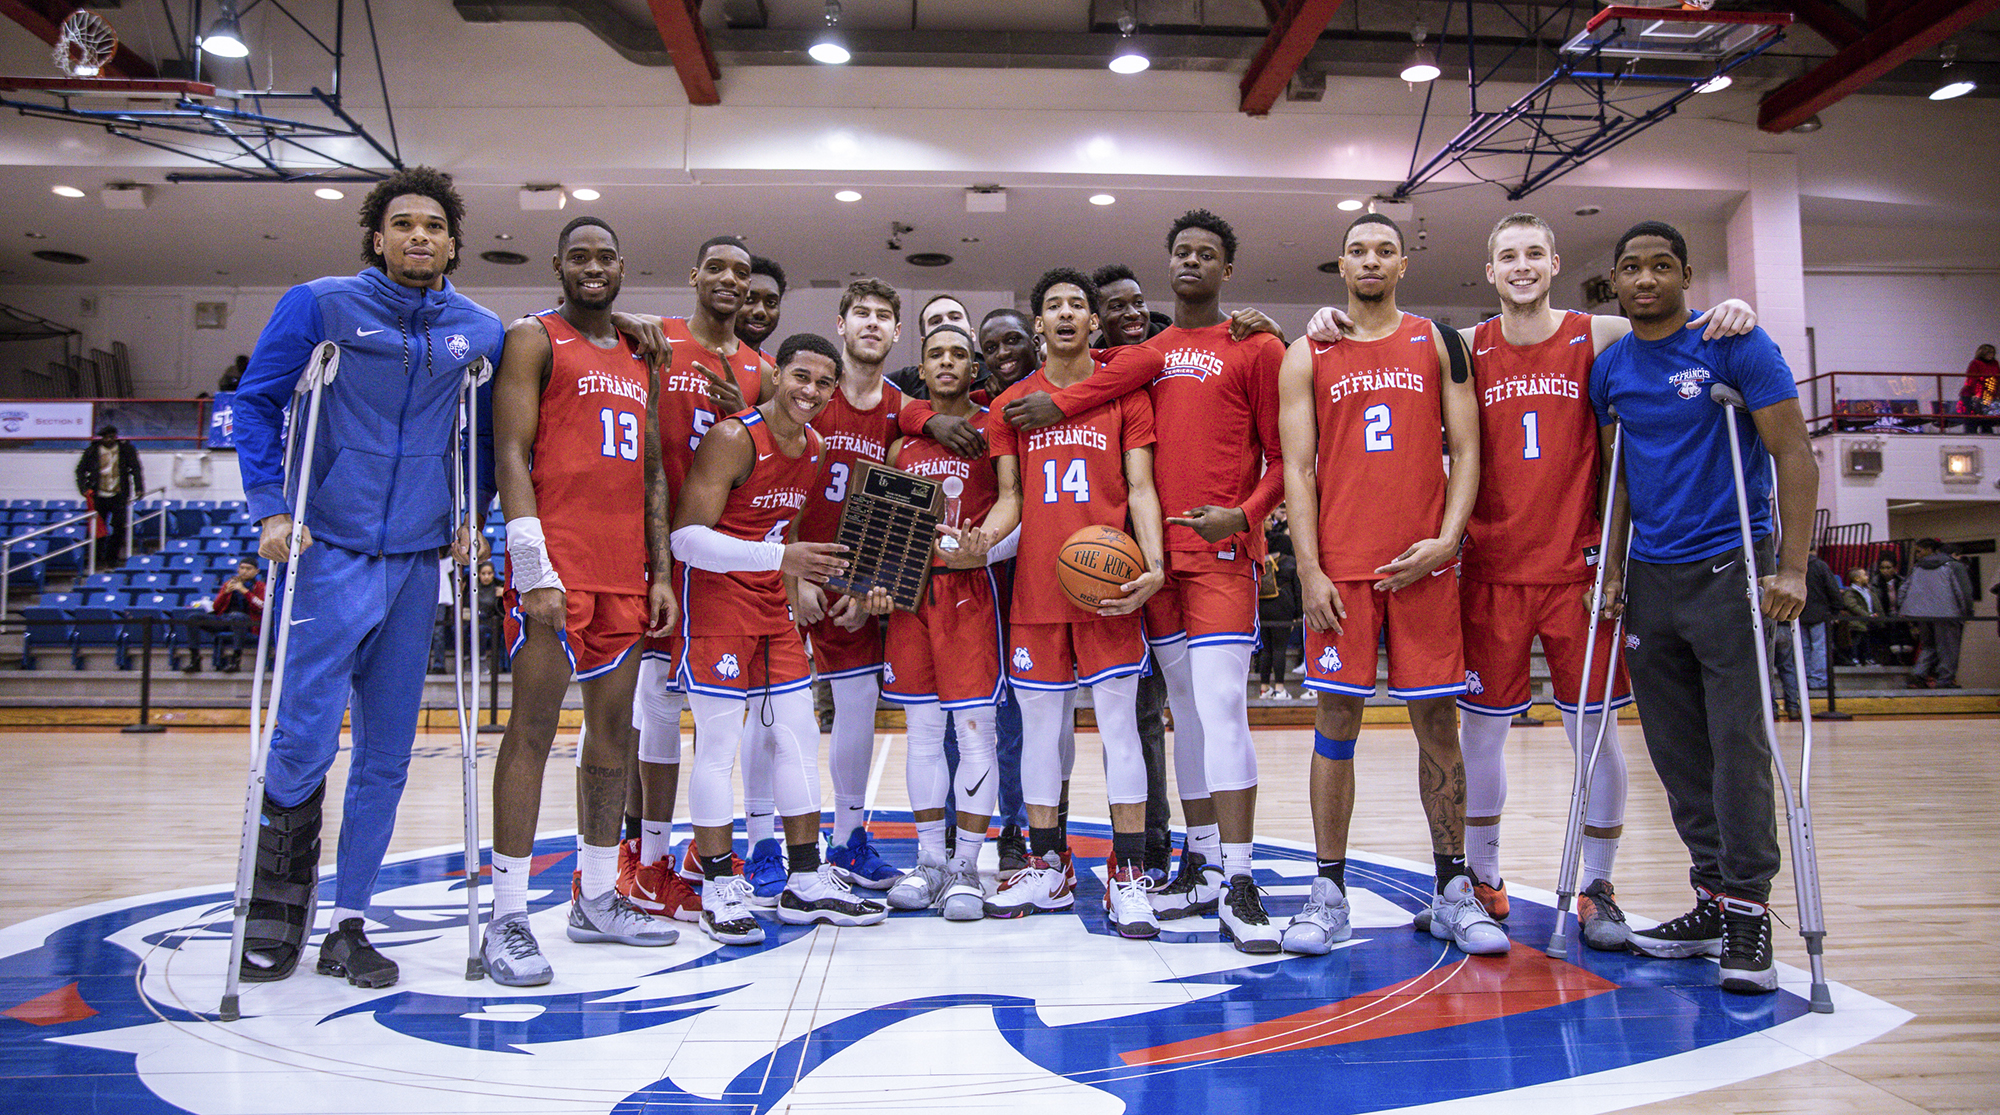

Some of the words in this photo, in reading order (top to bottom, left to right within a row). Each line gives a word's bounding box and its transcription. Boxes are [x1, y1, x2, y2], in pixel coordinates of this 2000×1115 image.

[1164, 352, 1224, 376] FRANCIS
[1165, 347, 1216, 356] ROOKLYN
[1341, 367, 1410, 380] BROOKLYN
[1496, 373, 1566, 385] BROOKLYN
[600, 407, 638, 462] 13
[688, 407, 716, 452] 5
[1036, 424, 1096, 434] BROOKLYN
[1363, 403, 1394, 453] 2
[1521, 410, 1541, 460] 1
[824, 461, 850, 503] 3
[1043, 458, 1090, 504] 14
[764, 520, 790, 543] 4
[1074, 550, 1100, 569] THE
[1103, 553, 1133, 579] ROCK
